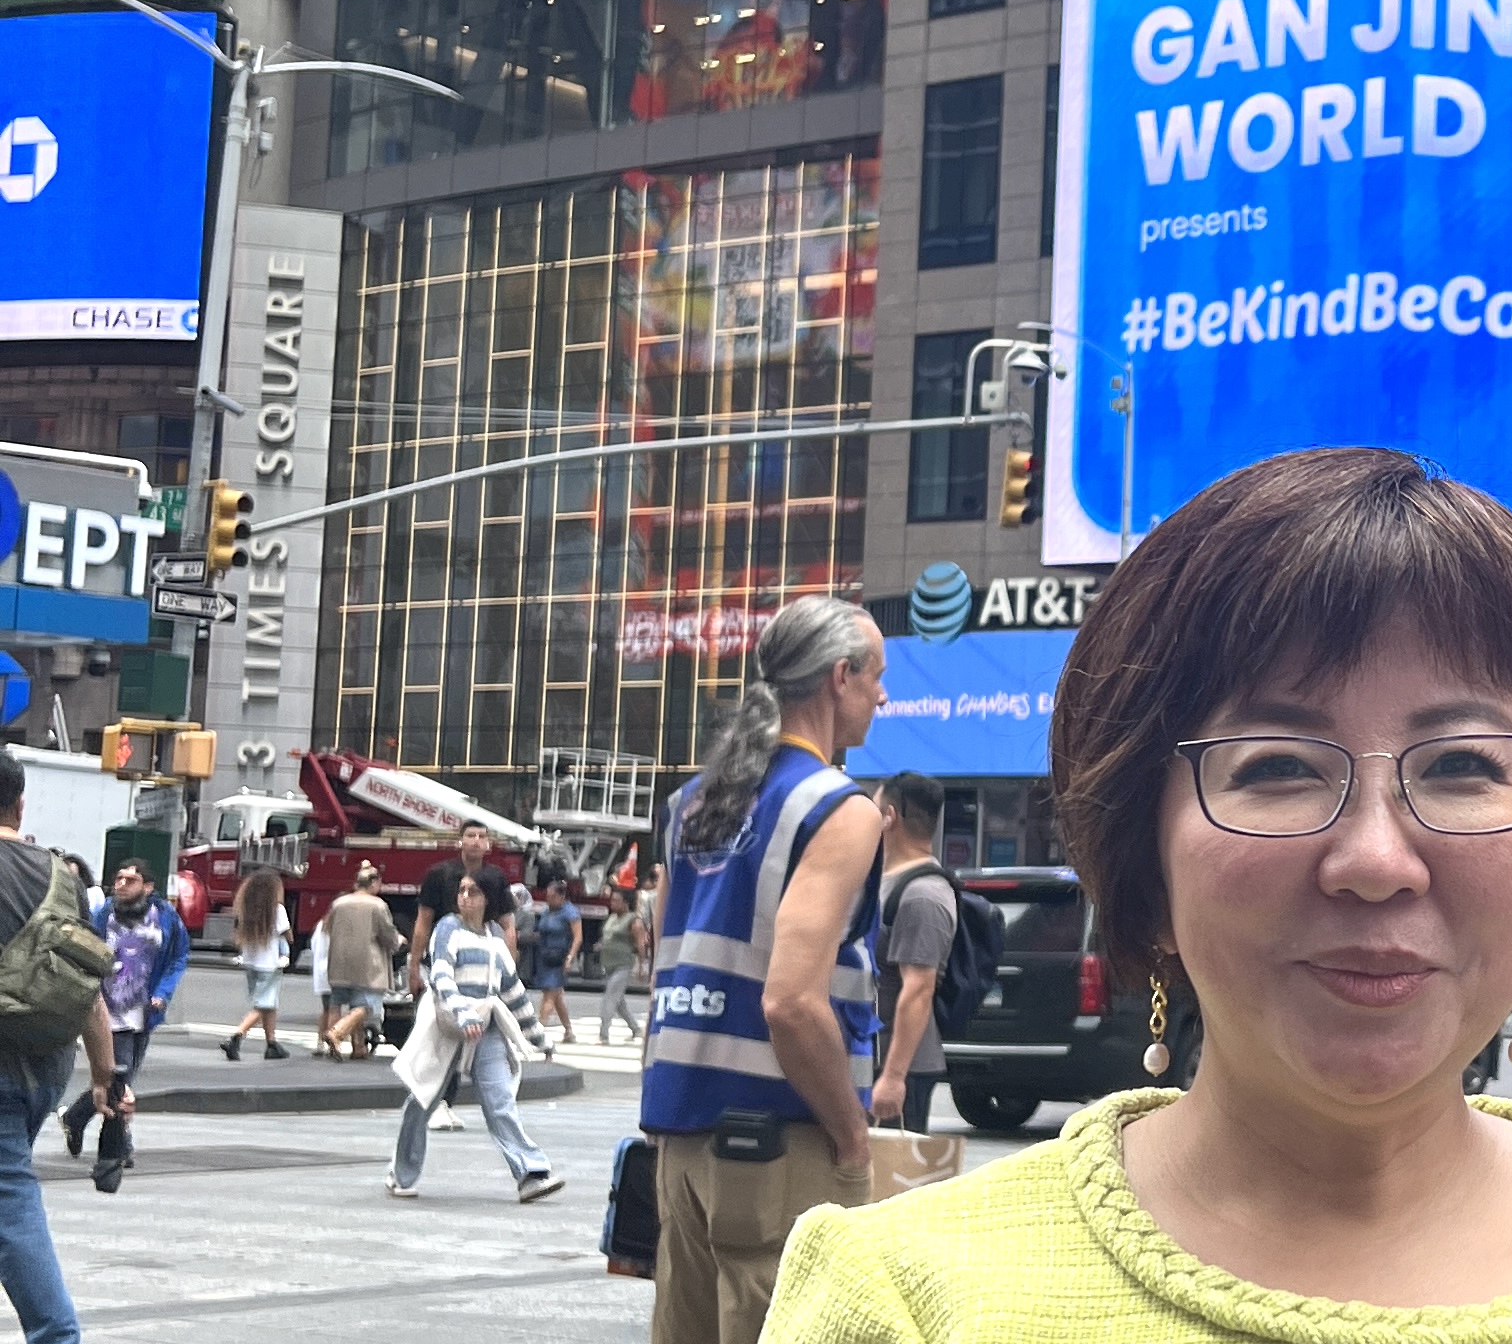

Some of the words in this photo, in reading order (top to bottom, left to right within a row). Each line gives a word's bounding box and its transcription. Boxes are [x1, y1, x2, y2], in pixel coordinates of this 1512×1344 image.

[1136, 74, 1487, 186] WORLD
[1139, 204, 1268, 253] presents
[72, 307, 174, 331] CHASE
[256, 254, 306, 480] SQUARE
[23, 501, 166, 597] EPT
[161, 591, 185, 608] ONE
[201, 597, 227, 613] WAY
[240, 535, 291, 706] TIMES
[978, 576, 1096, 626] AT&T
[955, 690, 1030, 720] CHANGES
[237, 739, 276, 769] 3
[402, 792, 437, 818] SHORE
